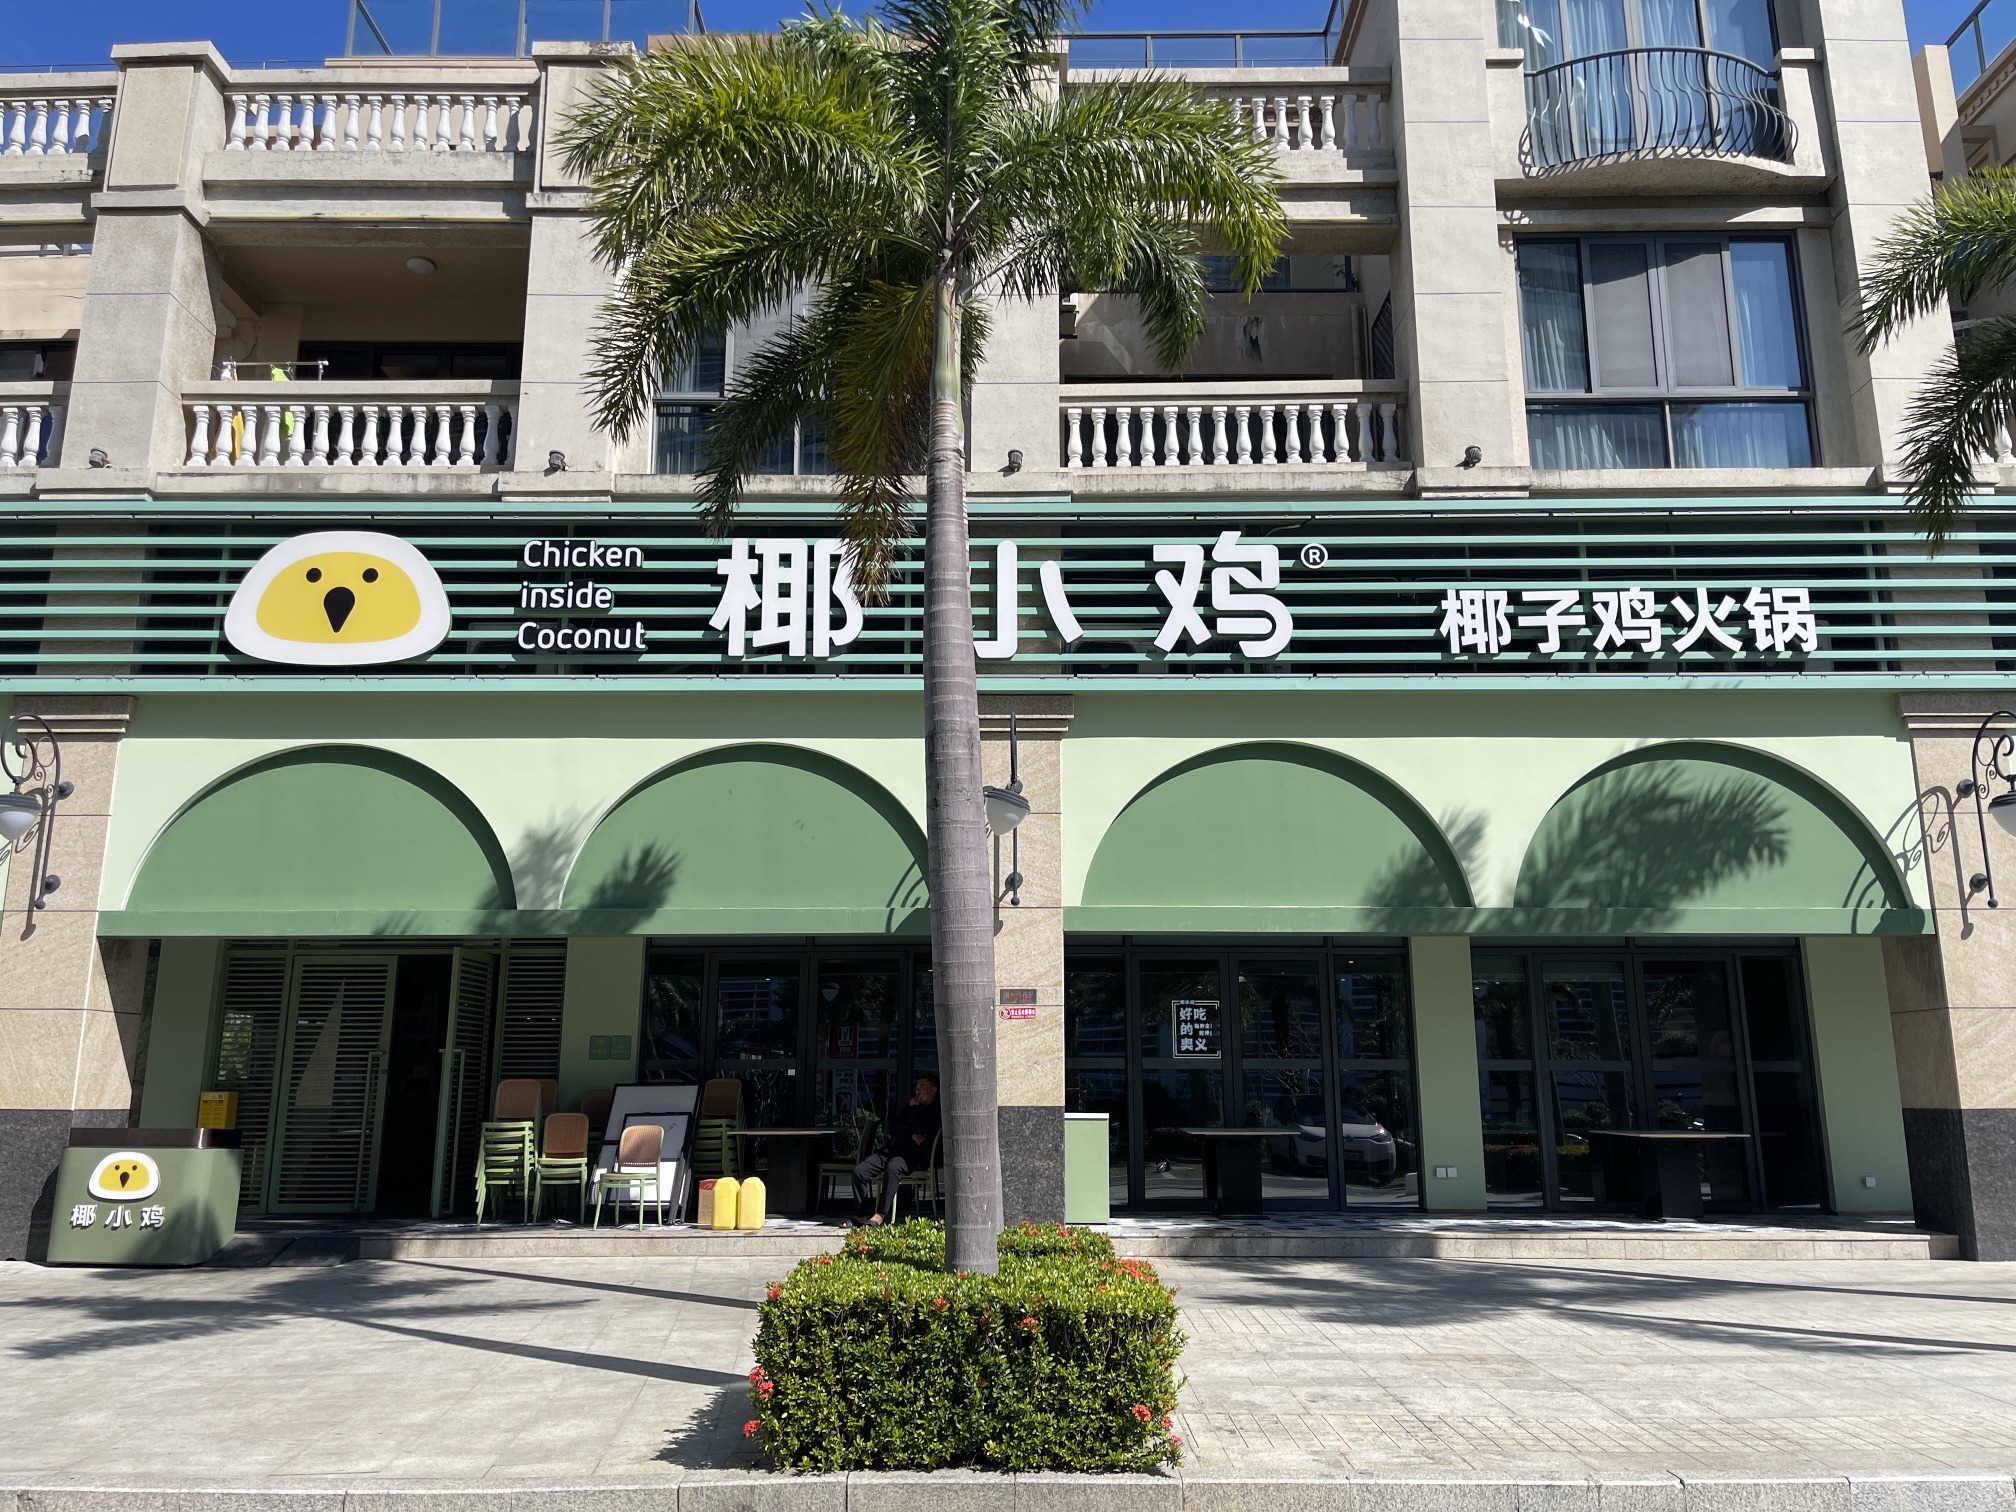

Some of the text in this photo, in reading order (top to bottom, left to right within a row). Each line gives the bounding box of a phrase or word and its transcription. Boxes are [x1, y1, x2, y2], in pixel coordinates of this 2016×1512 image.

[522, 540, 643, 569] Chicken
[520, 580, 612, 610] inside
[1439, 586, 1818, 655] 椰子鸡火锅
[517, 621, 648, 651] Coconut
[1179, 1007, 1207, 1021] 好吃
[1180, 1022, 1194, 1036] 的
[70, 1204, 166, 1229] 椰小鸡
